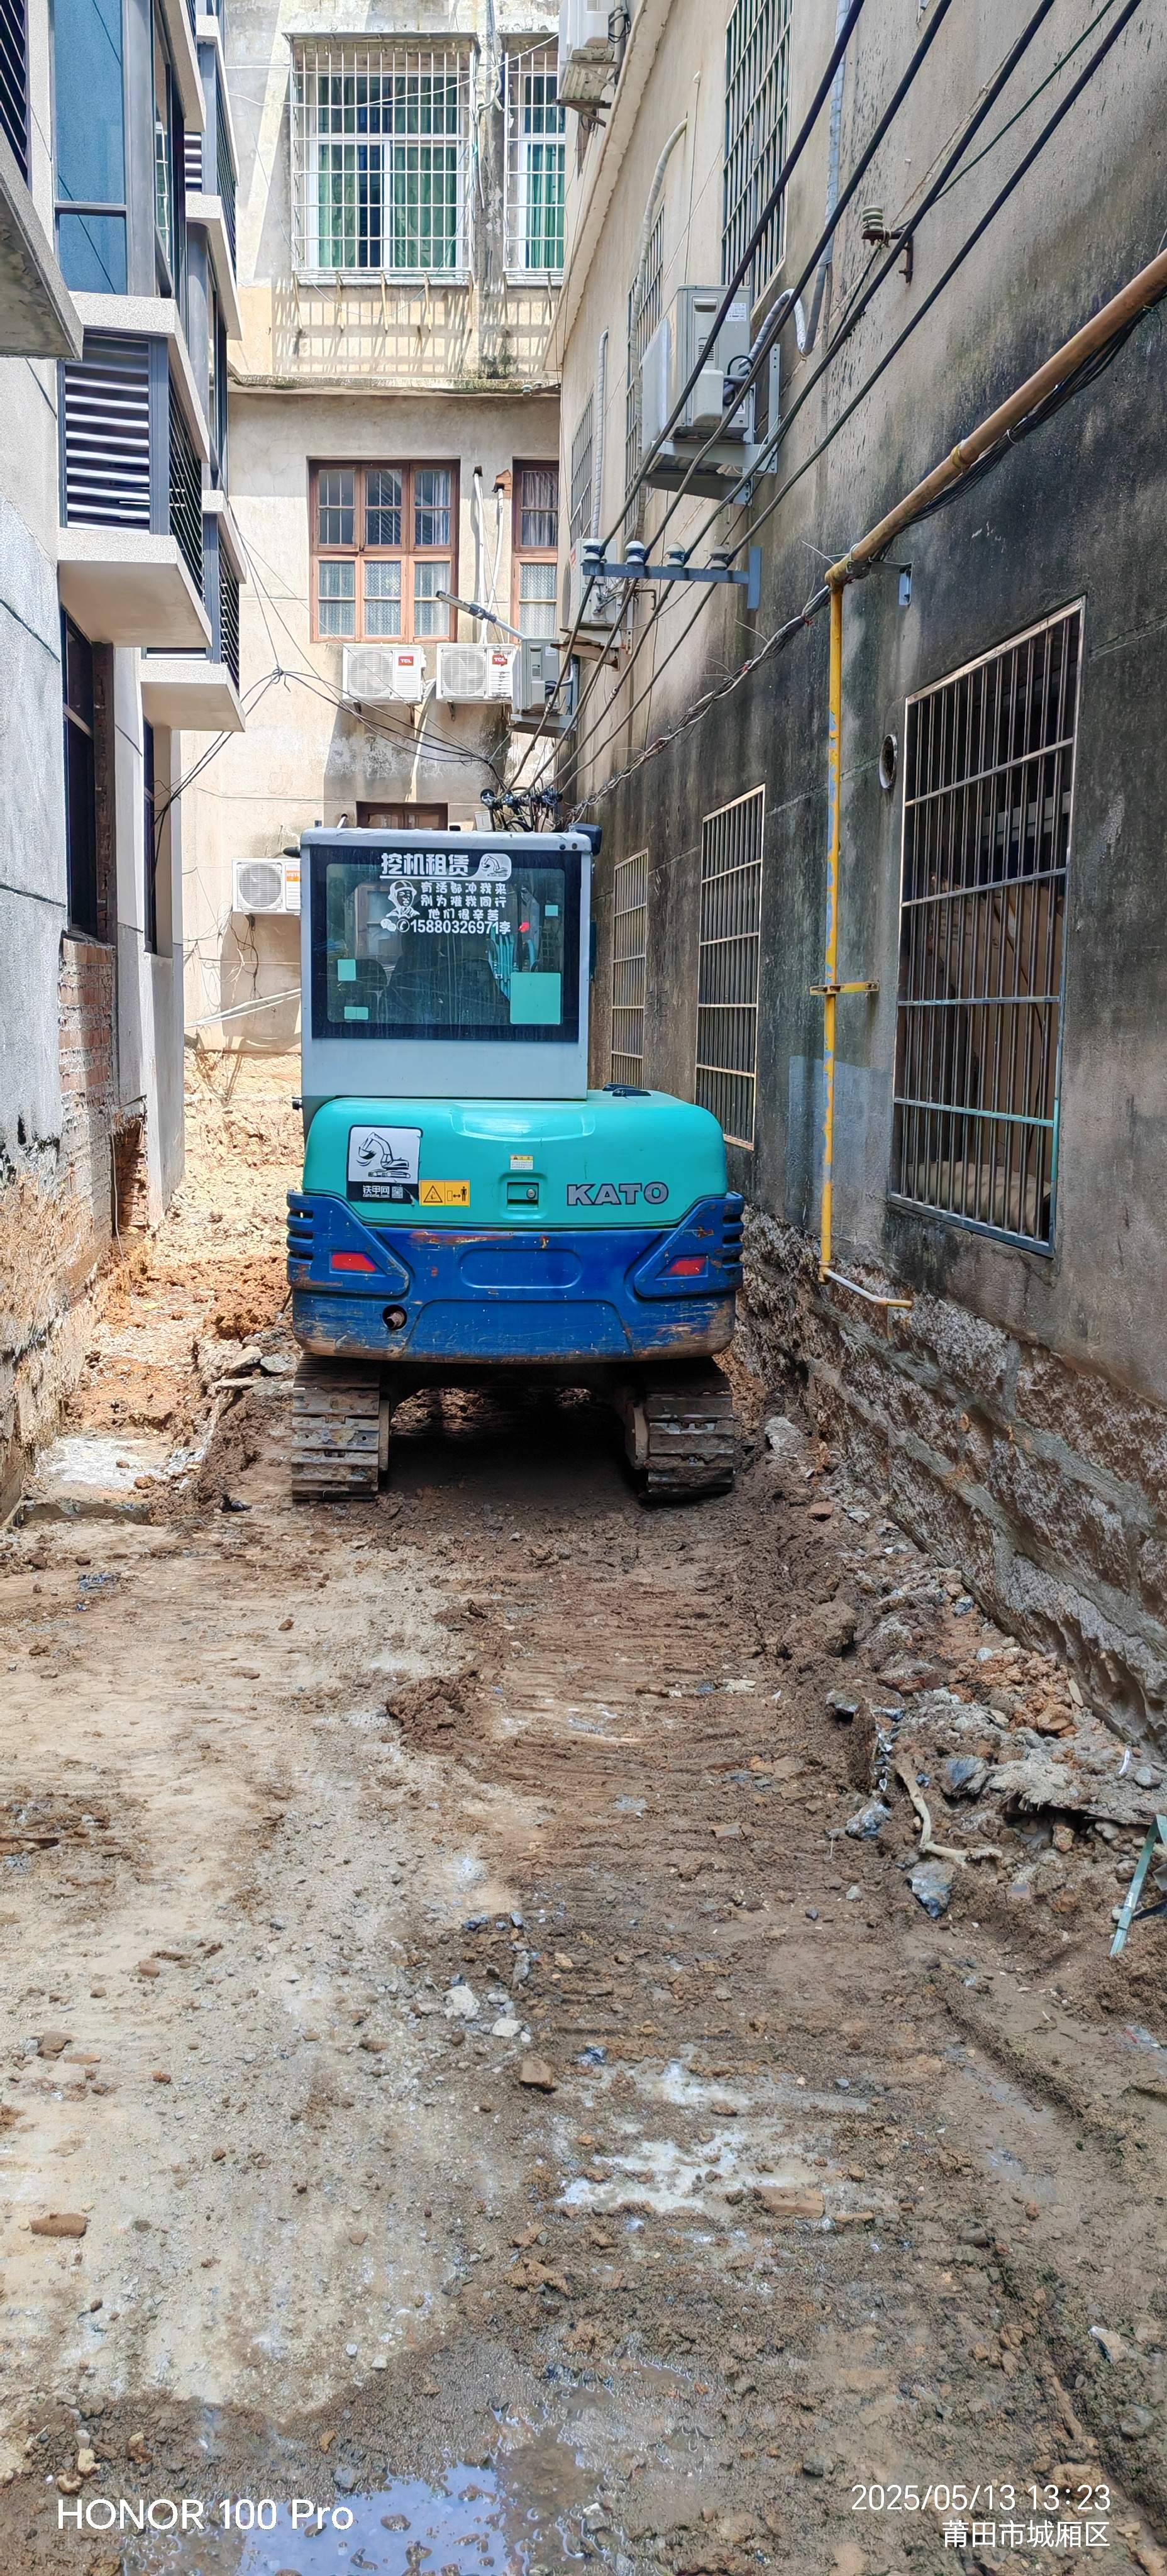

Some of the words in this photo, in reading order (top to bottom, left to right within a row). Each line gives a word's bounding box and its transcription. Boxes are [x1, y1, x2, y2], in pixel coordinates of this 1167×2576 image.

[380, 852, 470, 876] 挖机租赁
[421, 881, 507, 895] 有活都冲我来
[421, 895, 507, 908] 别为难我同行
[428, 908, 499, 921] 他们很辛苦
[567, 1182, 669, 1206] KATO
